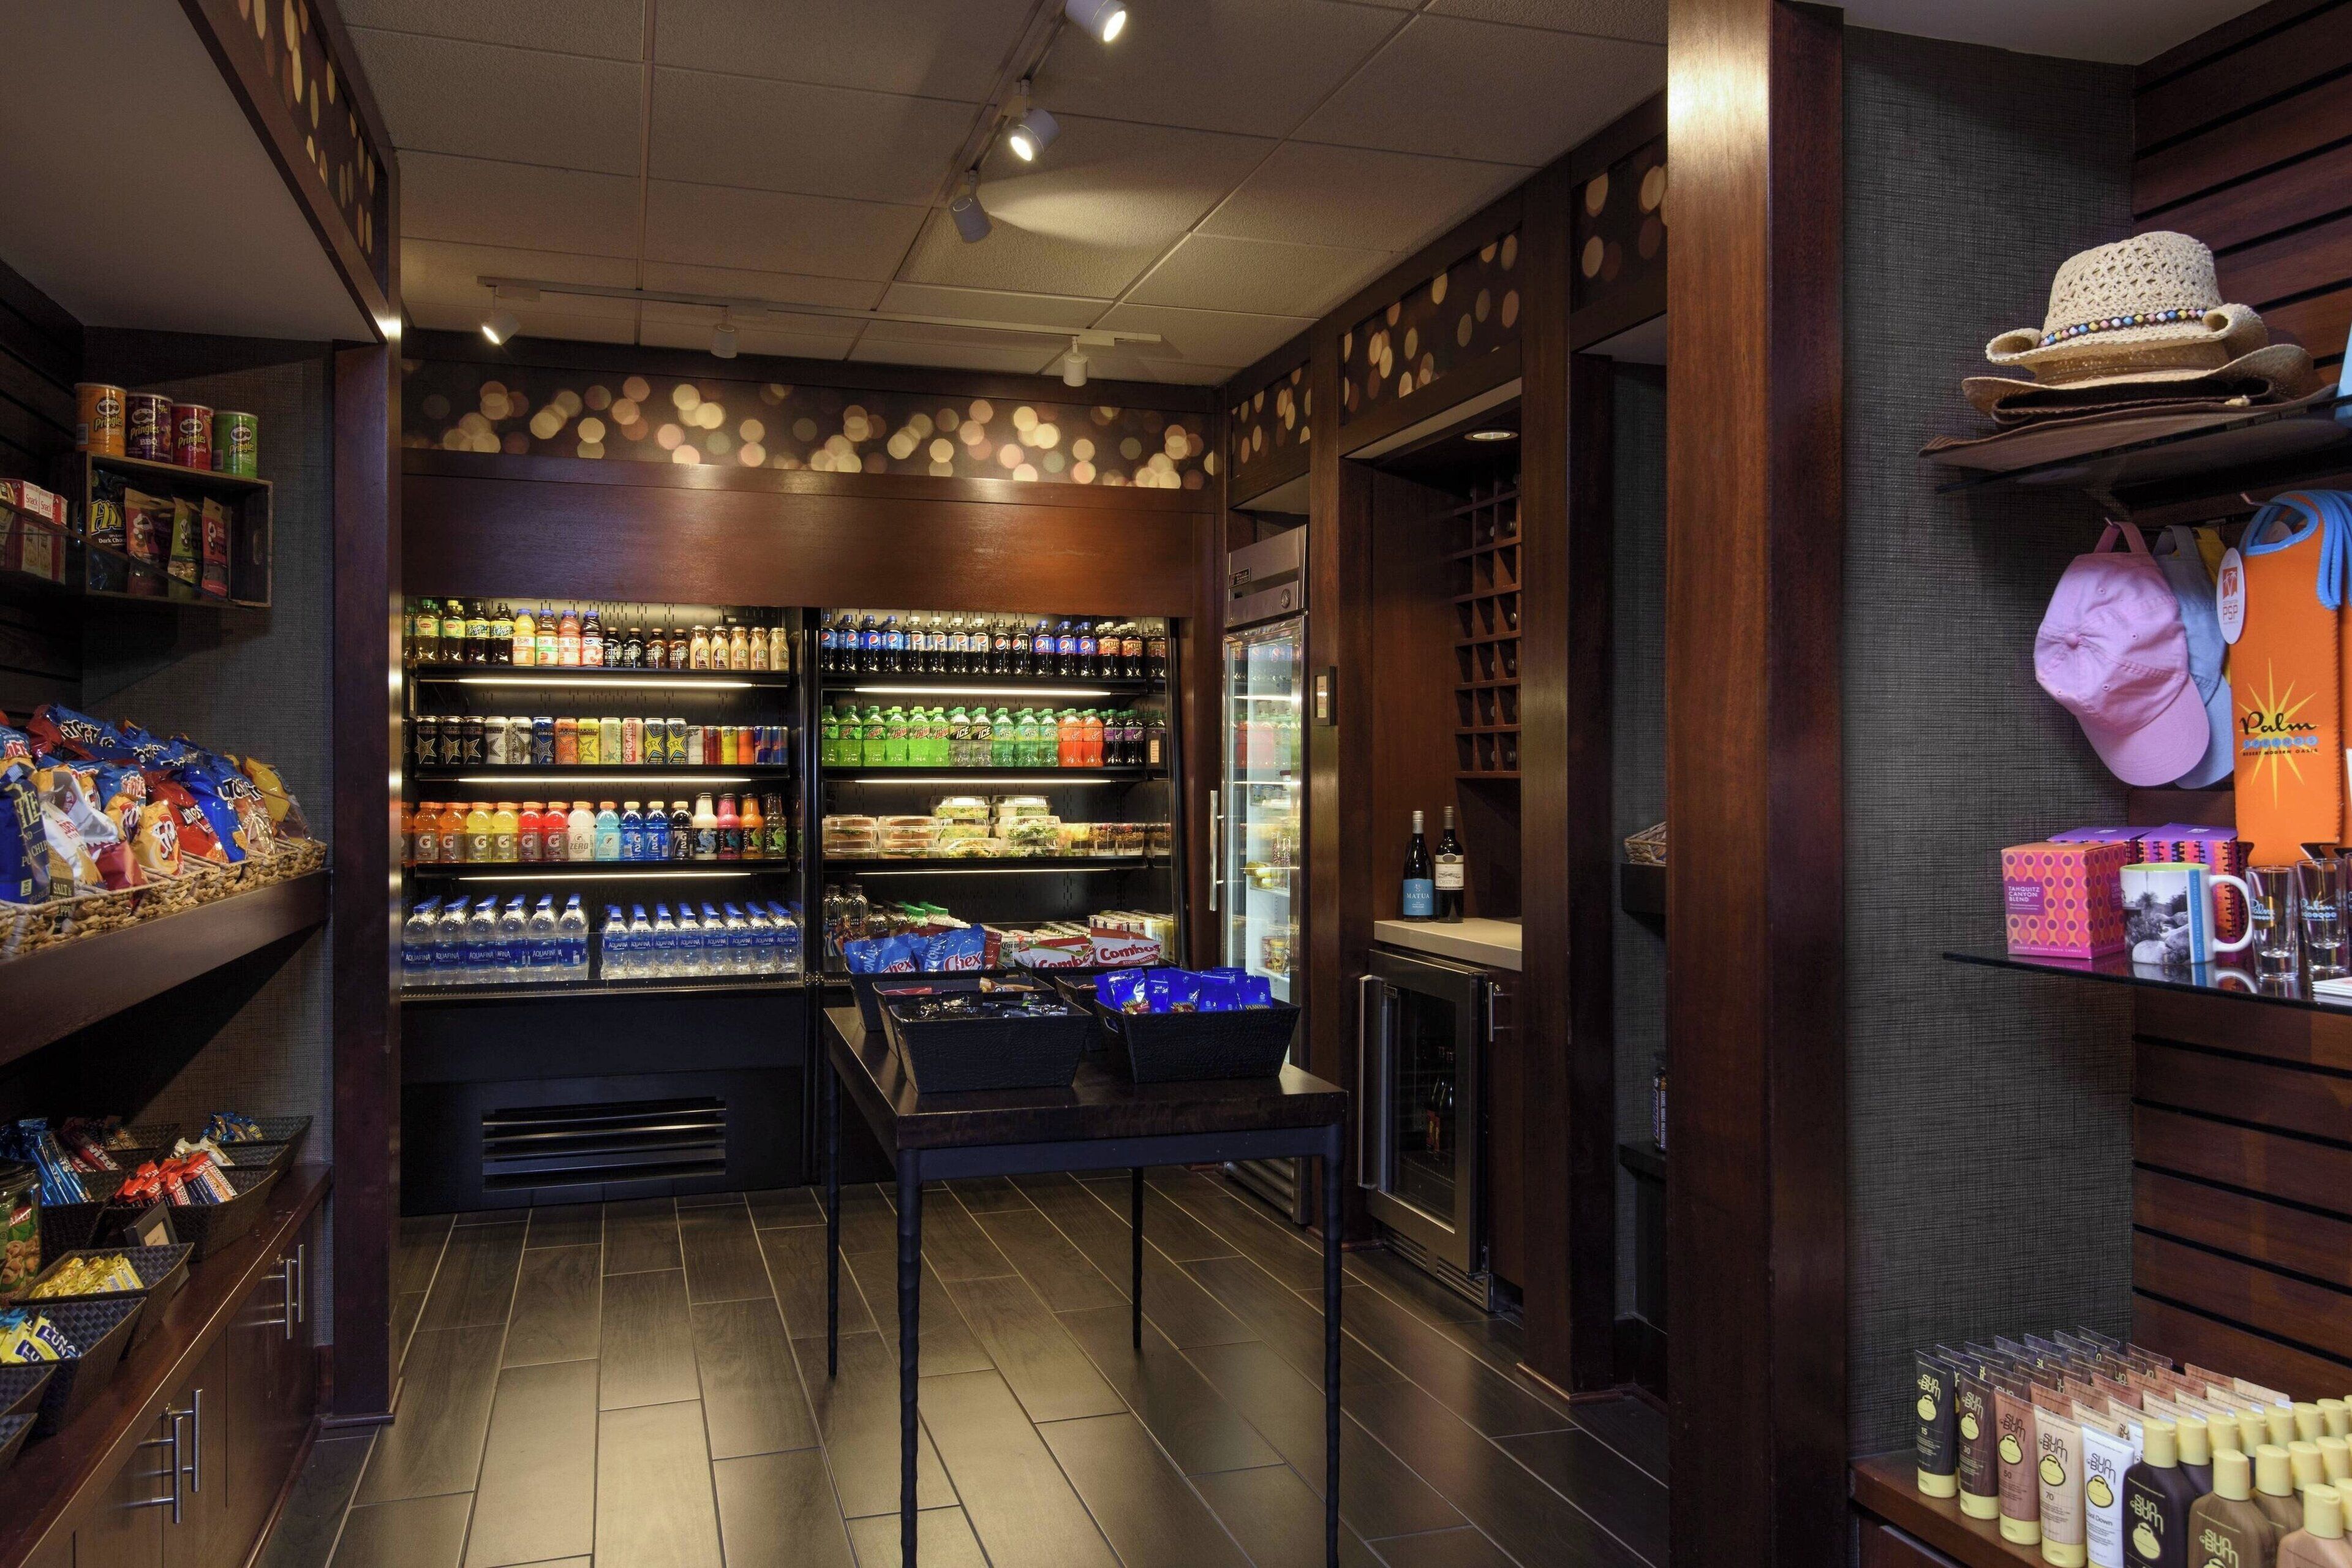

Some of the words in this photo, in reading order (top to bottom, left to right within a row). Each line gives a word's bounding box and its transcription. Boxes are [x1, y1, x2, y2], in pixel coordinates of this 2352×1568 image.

[94, 415, 123, 432] Pringles
[130, 423, 159, 439] Pringles
[139, 438, 158, 447] BBQ
[177, 434, 206, 449] Pringles
[228, 443, 255, 457] Pringles
[2223, 604, 2238, 620] PSP
[2239, 710, 2318, 735] Palm
[956, 726, 970, 739] ICE
[978, 726, 991, 739] ICE
[1001, 941, 1020, 950] Coron
[1100, 944, 1161, 961] Combos
[944, 952, 981, 971] Chex
[1921, 1427, 1928, 1436] 15
[2003, 1470, 2012, 1479] 50
[2046, 1491, 2054, 1501] 70
[2095, 1515, 2113, 1526] Down
